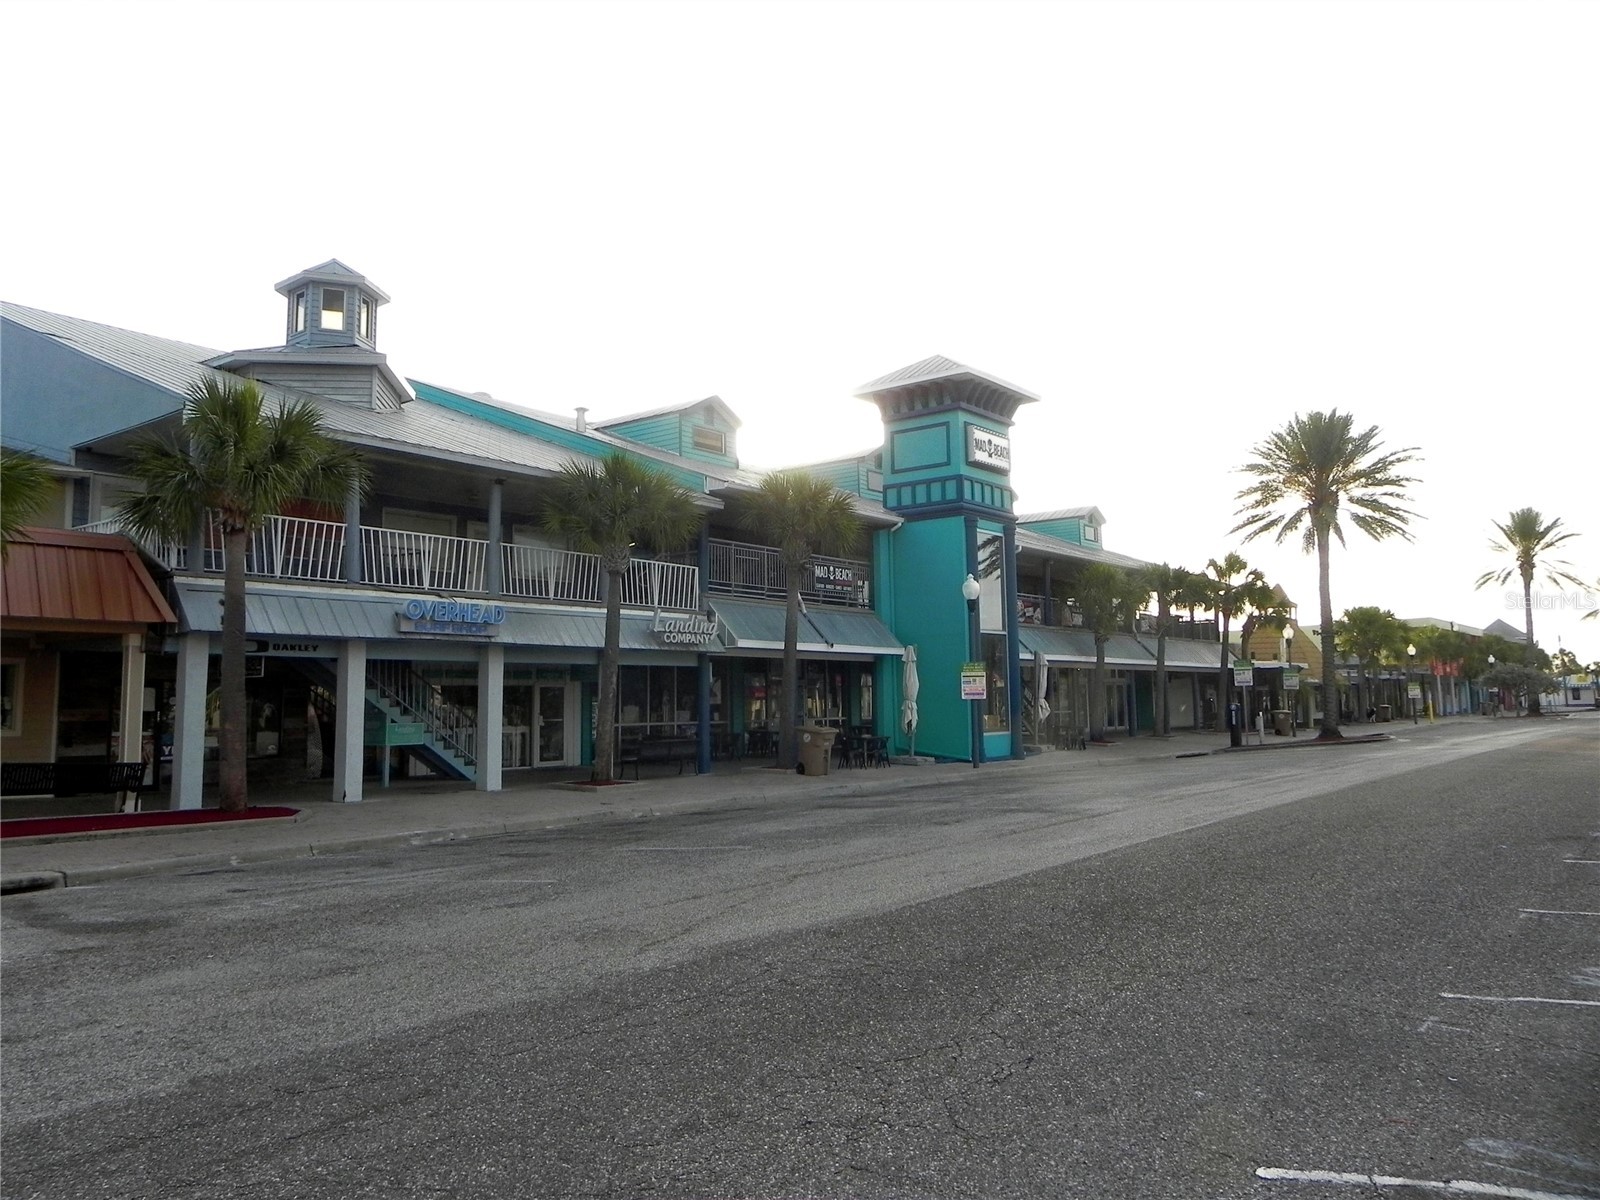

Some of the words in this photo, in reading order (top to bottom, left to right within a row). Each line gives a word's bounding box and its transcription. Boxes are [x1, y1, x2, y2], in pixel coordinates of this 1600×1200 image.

[974, 437, 987, 452] MAD
[993, 443, 1009, 459] BEACH
[815, 565, 828, 578] MAD
[835, 568, 852, 581] BEACH
[405, 599, 506, 624] OVERHEAD
[414, 622, 449, 633] SURF
[451, 624, 488, 634] SHOP
[654, 608, 719, 640] Landing
[664, 633, 710, 644] COMPANY
[272, 643, 319, 652] OAKLEY
